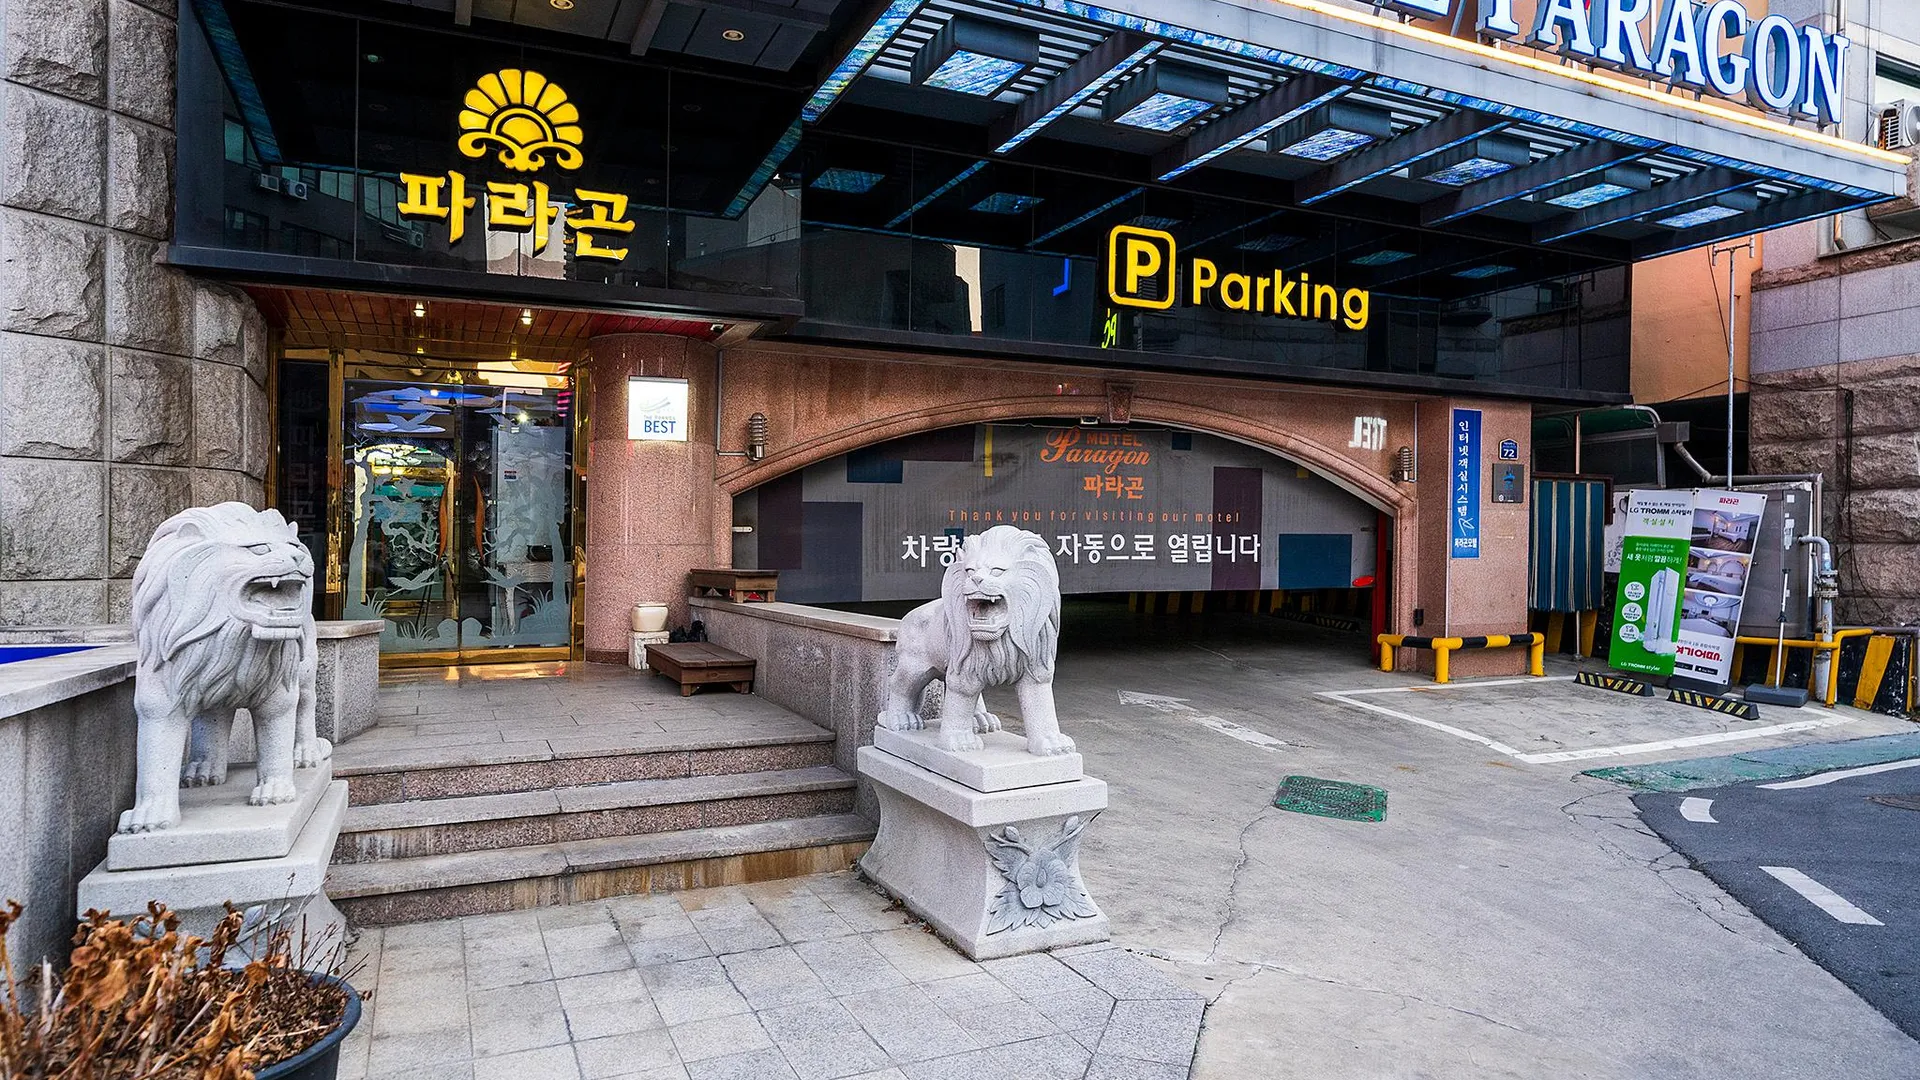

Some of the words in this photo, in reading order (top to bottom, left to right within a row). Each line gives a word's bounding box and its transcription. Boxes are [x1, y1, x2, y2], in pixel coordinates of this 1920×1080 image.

[397, 170, 636, 261] 파라곤
[1126, 238, 1162, 294] P
[1193, 257, 1370, 331] Parking
[644, 419, 676, 434] BEST
[1086, 432, 1143, 447] MOTEL
[1040, 429, 1151, 474] Paragon
[1503, 448, 1515, 458] 72
[1083, 474, 1145, 500] 파라곤
[1718, 497, 1740, 506] 파라곤
[949, 510, 1004, 522] Thank
[1011, 511, 1042, 523] you
[1050, 510, 1077, 521] for
[1084, 511, 1154, 523] visiting
[1161, 512, 1188, 523] our
[1195, 512, 1240, 523] motel
[1055, 533, 1157, 565] 자동으로
[1167, 533, 1261, 564] 열립니다
